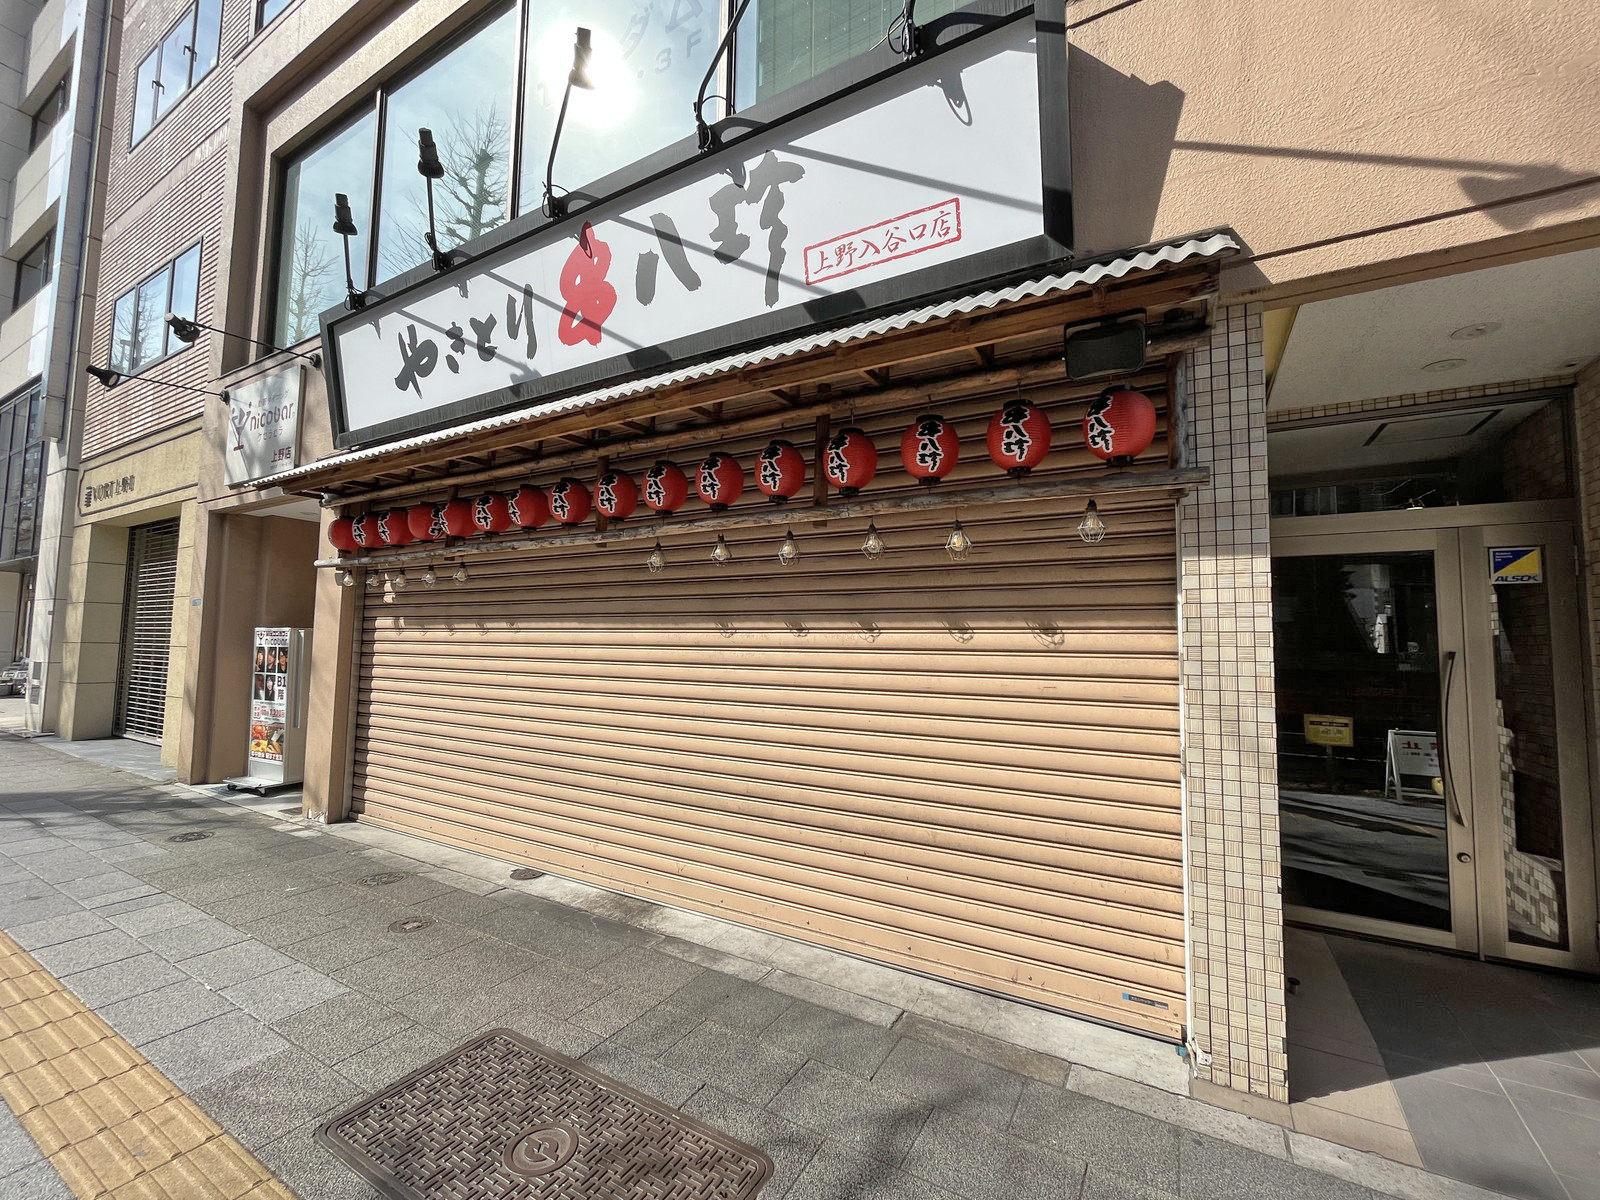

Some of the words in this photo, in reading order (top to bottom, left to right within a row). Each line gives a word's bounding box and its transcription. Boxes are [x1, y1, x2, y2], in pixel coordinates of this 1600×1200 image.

[813, 210, 952, 275] 上野入谷口店
[394, 283, 538, 400] やきとり
[249, 402, 294, 431] nicobar
[270, 446, 292, 463] 上野店
[1495, 574, 1539, 583] ALSOK
[277, 676, 287, 687] B1
